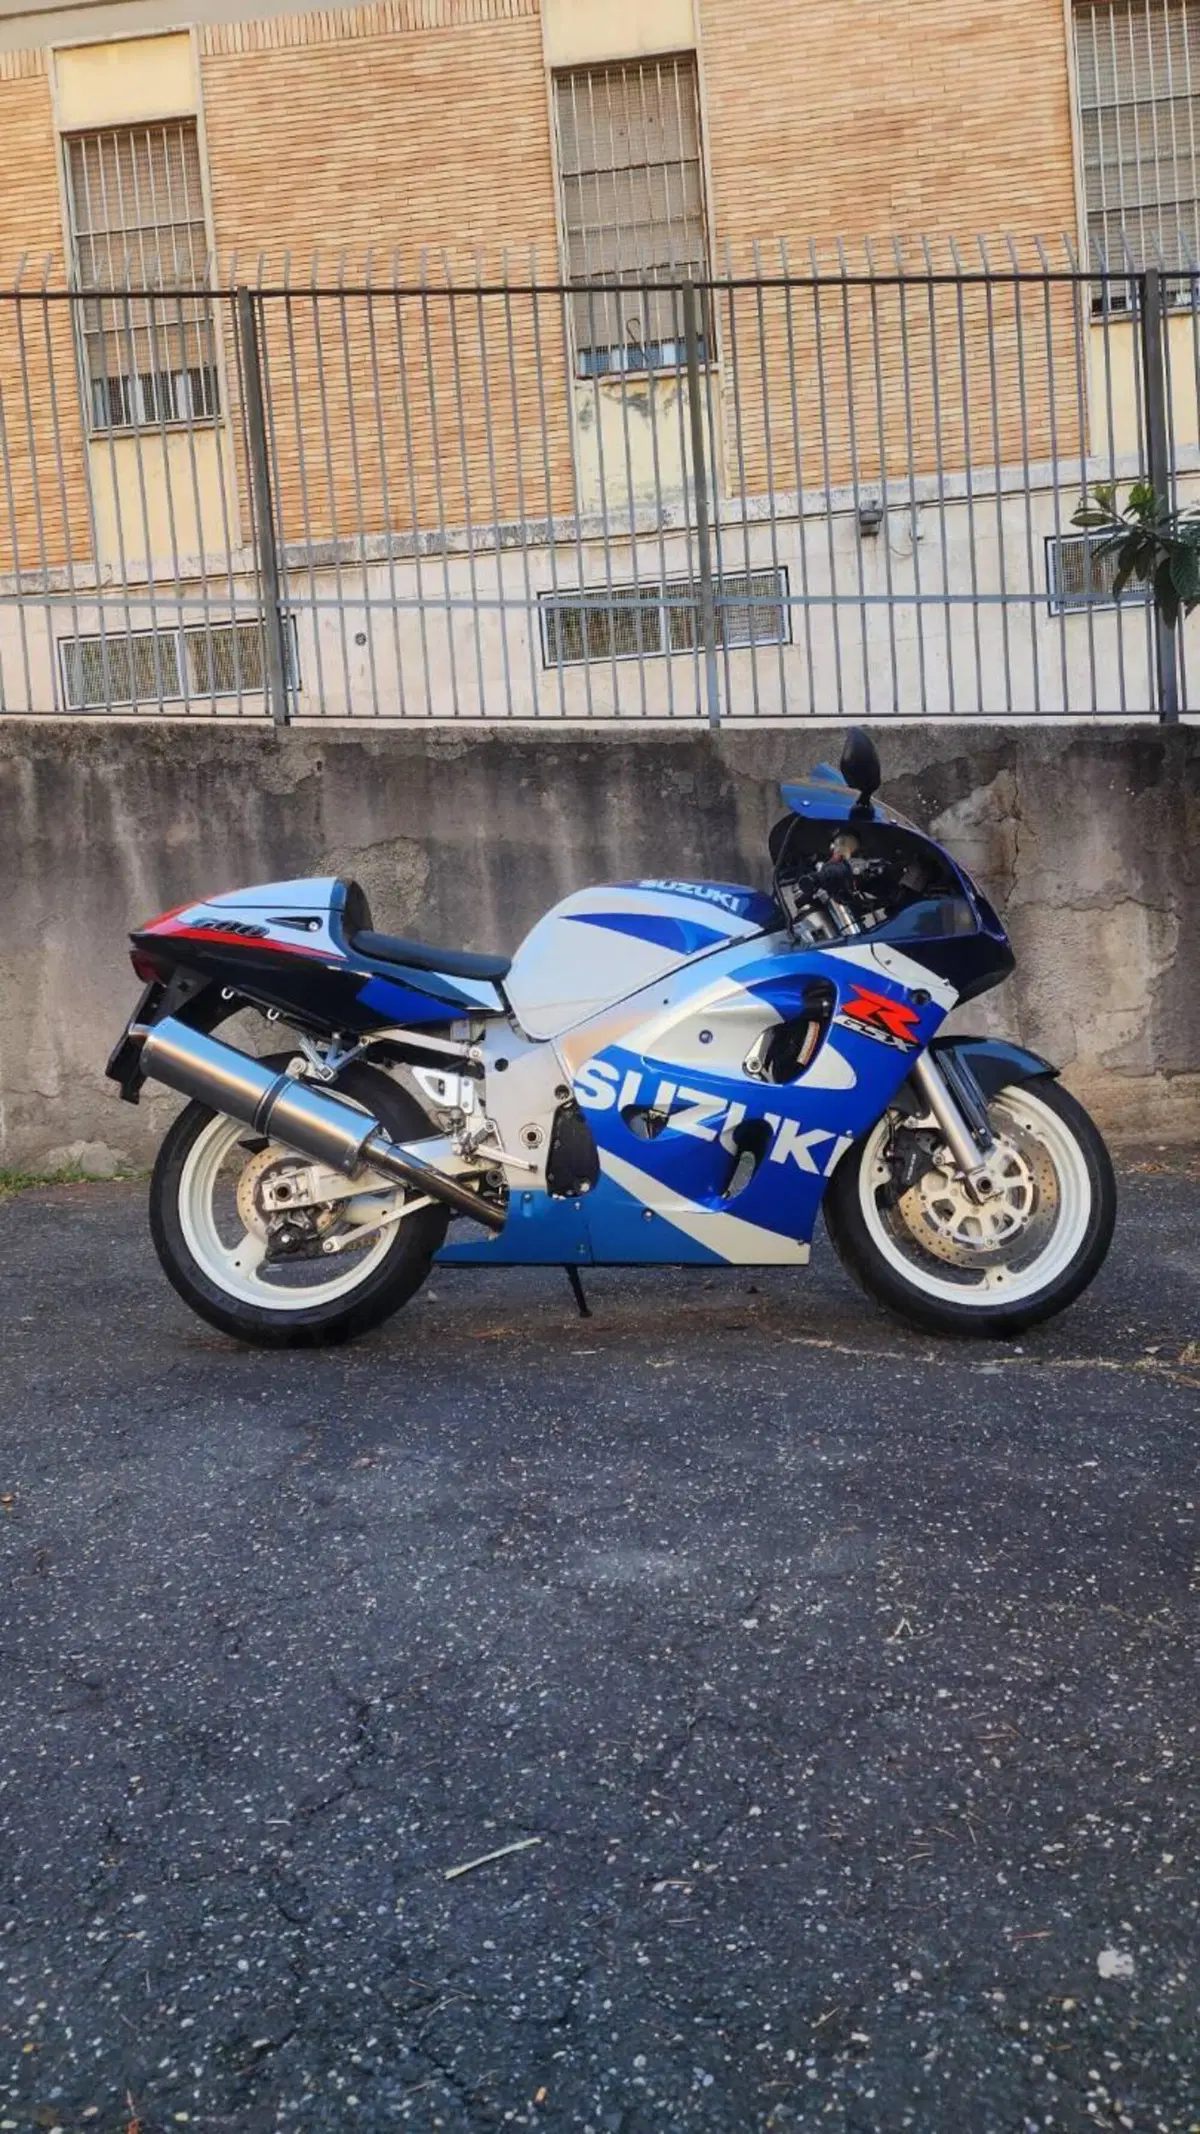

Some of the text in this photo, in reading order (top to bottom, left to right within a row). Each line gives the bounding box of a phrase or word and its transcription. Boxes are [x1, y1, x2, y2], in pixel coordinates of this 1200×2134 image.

[638, 879, 741, 912] SUZUKI
[840, 983, 920, 1044] R
[572, 1058, 855, 1178] SUZUKI
